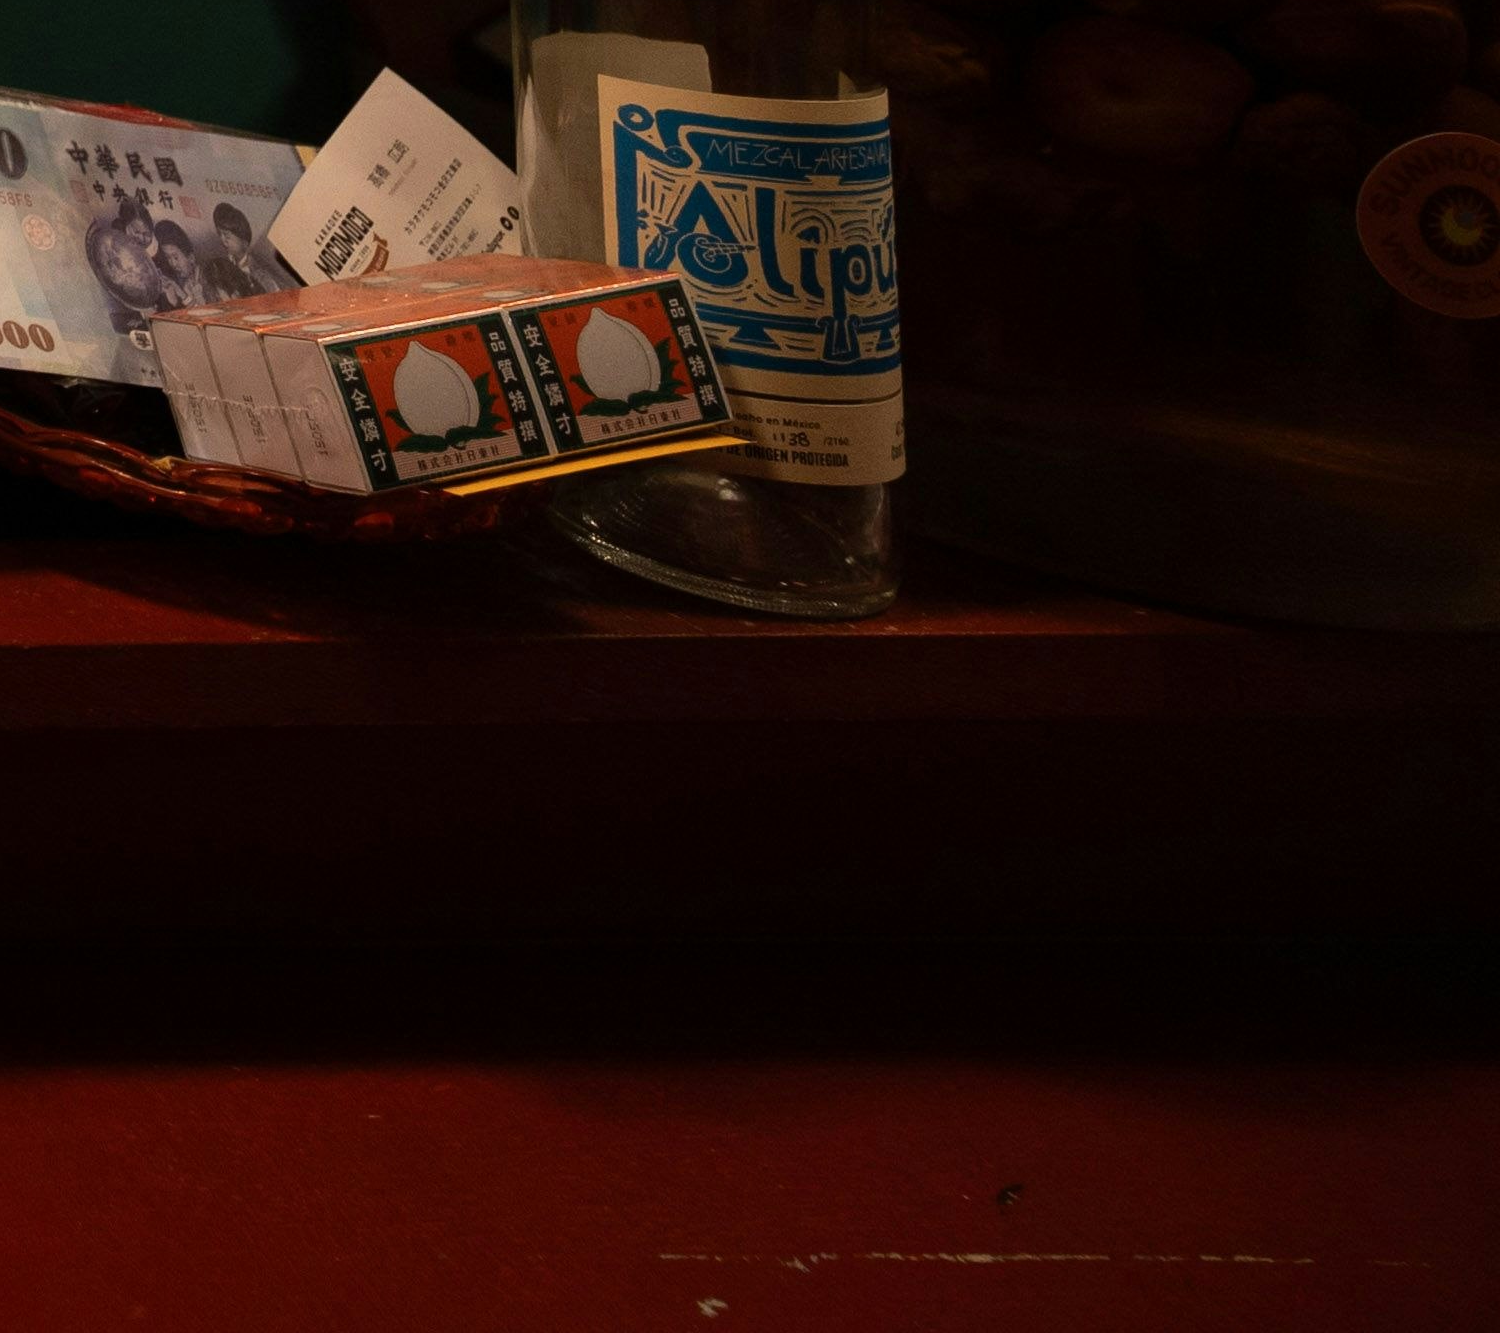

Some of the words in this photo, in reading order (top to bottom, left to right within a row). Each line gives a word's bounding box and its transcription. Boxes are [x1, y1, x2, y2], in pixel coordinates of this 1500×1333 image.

[66, 140, 184, 188] 中華民國
[705, 138, 813, 171] MEZCAL
[92, 180, 176, 211] 中央銀行
[314, 205, 375, 282] MOCOMOCO
[744, 445, 789, 464] ORIGEN
[791, 451, 849, 468] PROTEGIDA
